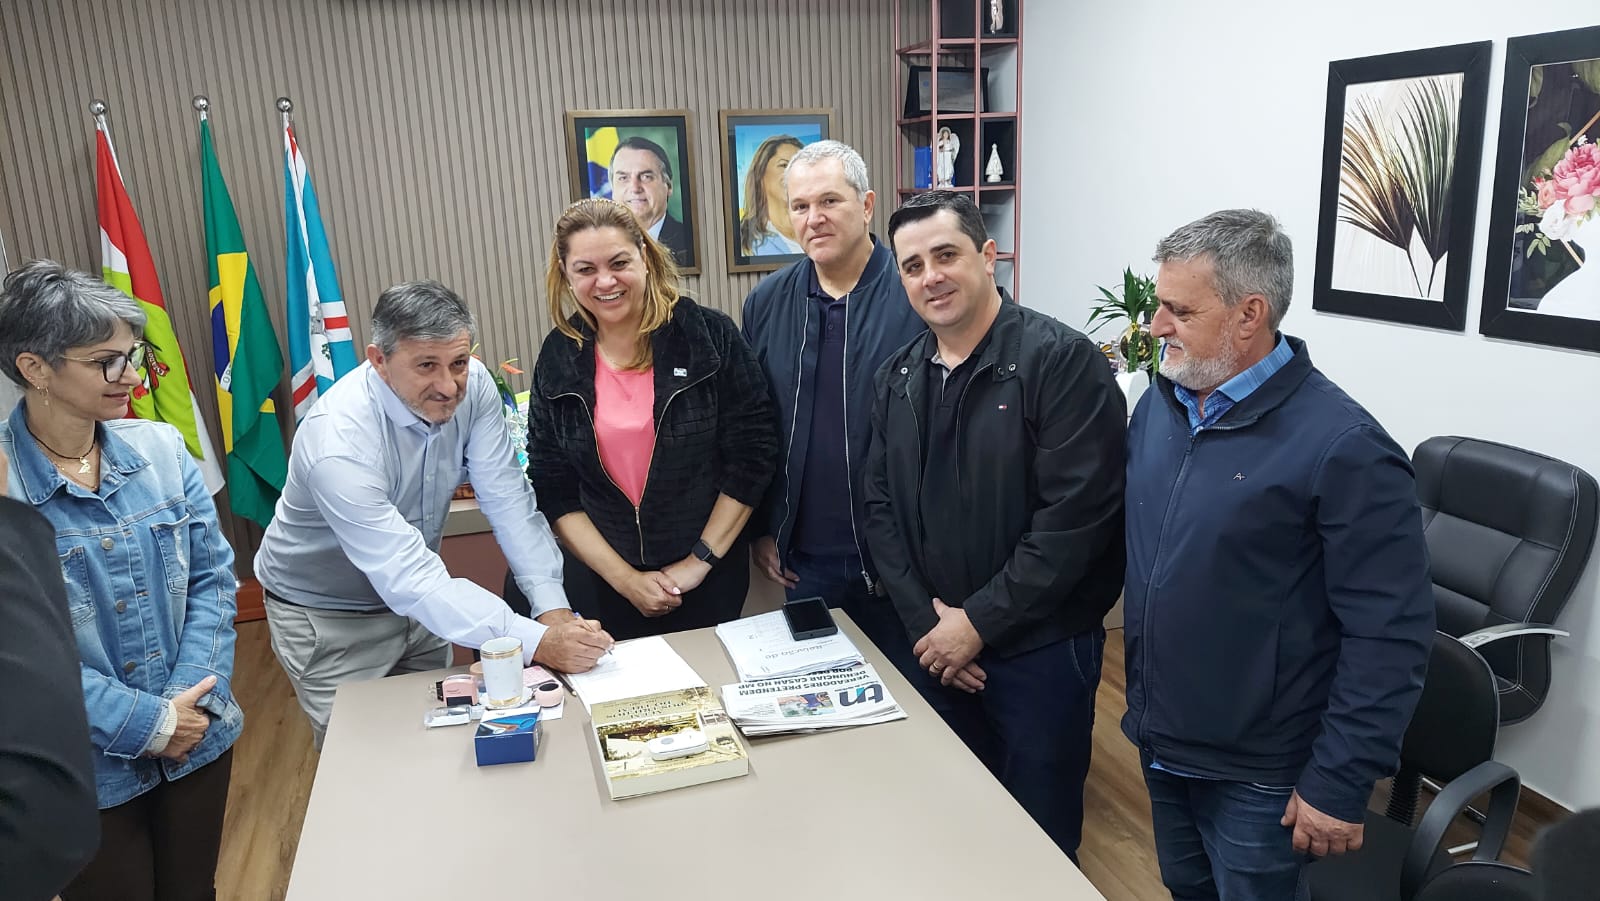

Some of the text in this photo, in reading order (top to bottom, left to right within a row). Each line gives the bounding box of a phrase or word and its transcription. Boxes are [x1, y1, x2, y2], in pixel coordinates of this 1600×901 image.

[774, 678, 808, 686] CASAN
[803, 674, 870, 689] VEREADORES
[809, 671, 866, 682] DENUNCIAR
[739, 684, 802, 696] PRETENDEM
[839, 684, 883, 707] tn
